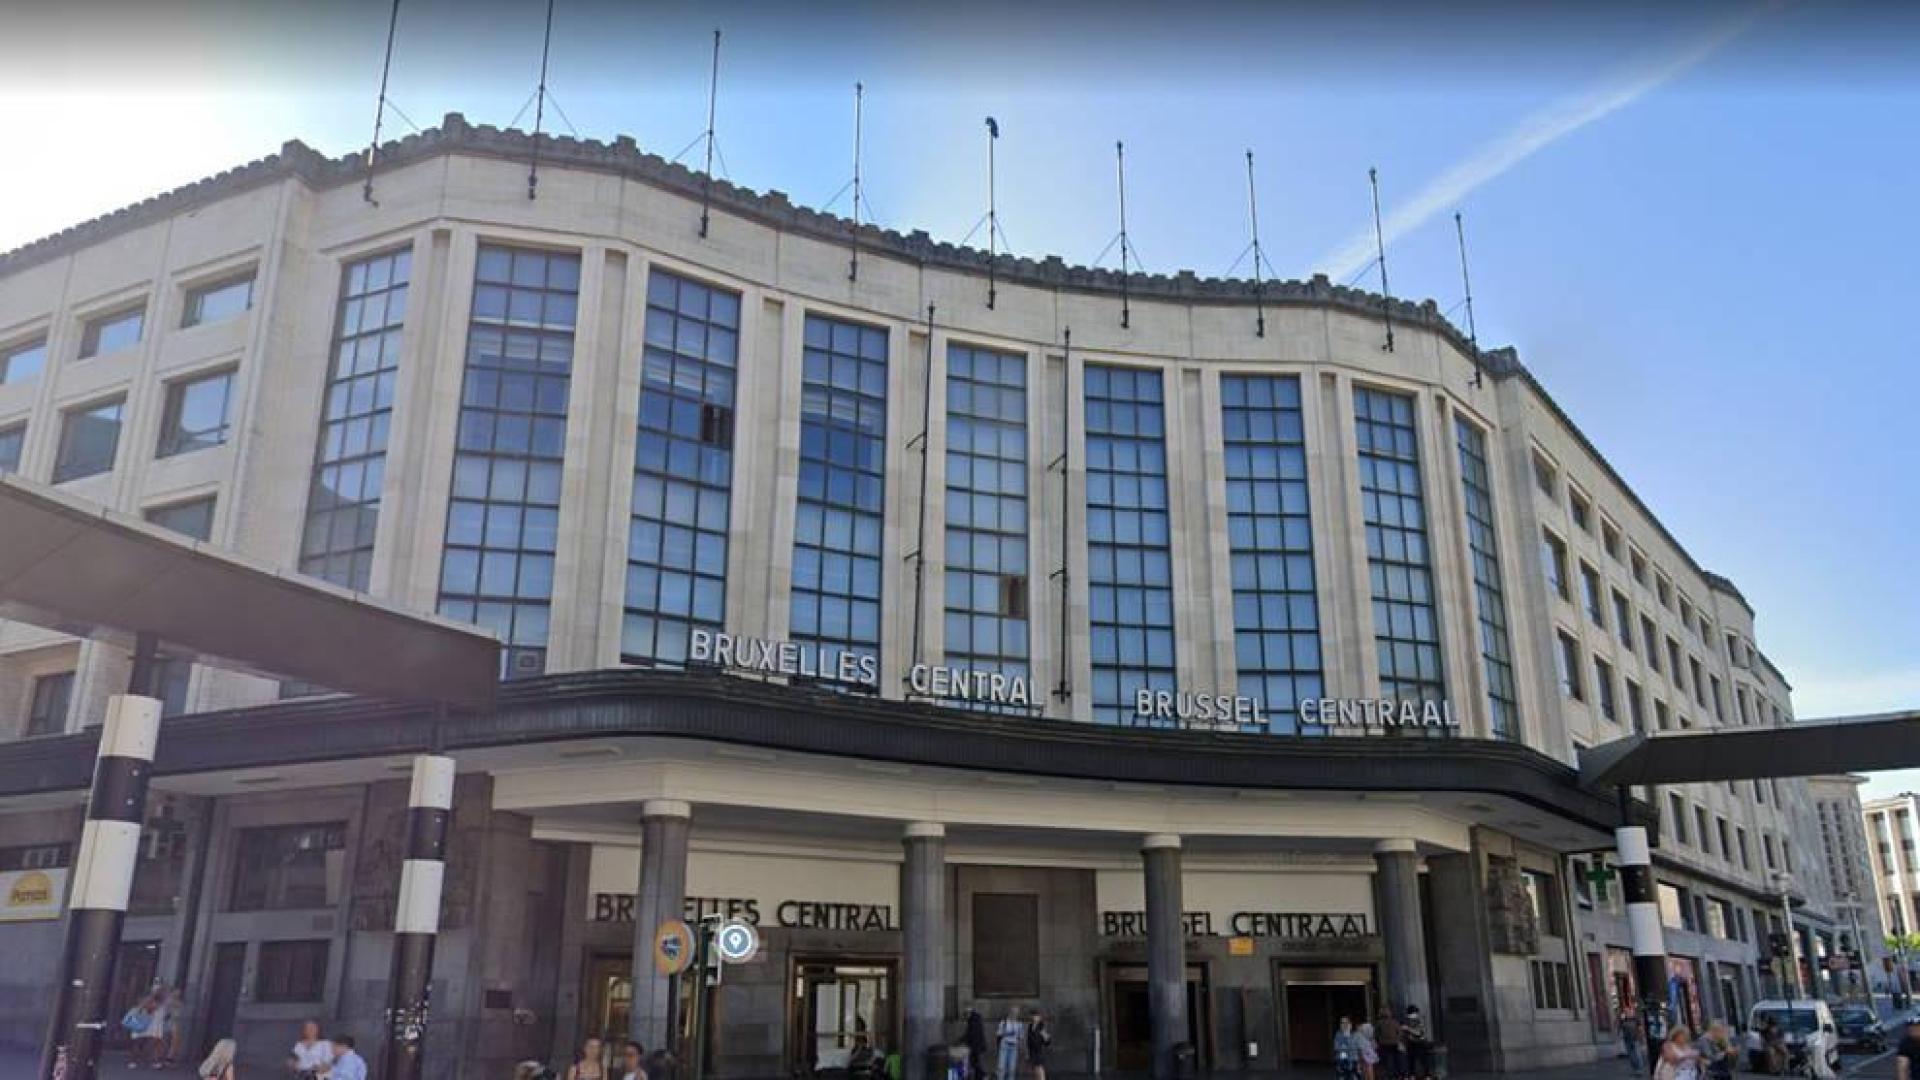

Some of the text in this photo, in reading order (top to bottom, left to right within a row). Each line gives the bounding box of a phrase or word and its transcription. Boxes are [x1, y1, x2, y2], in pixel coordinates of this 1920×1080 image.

[691, 629, 1043, 706] BRUXELLES CENTRAL
[1137, 689, 1459, 727] BRUSSEL CENTRAAL
[777, 900, 901, 931] CENTRAL
[1231, 911, 1379, 938] CENTRAAL
